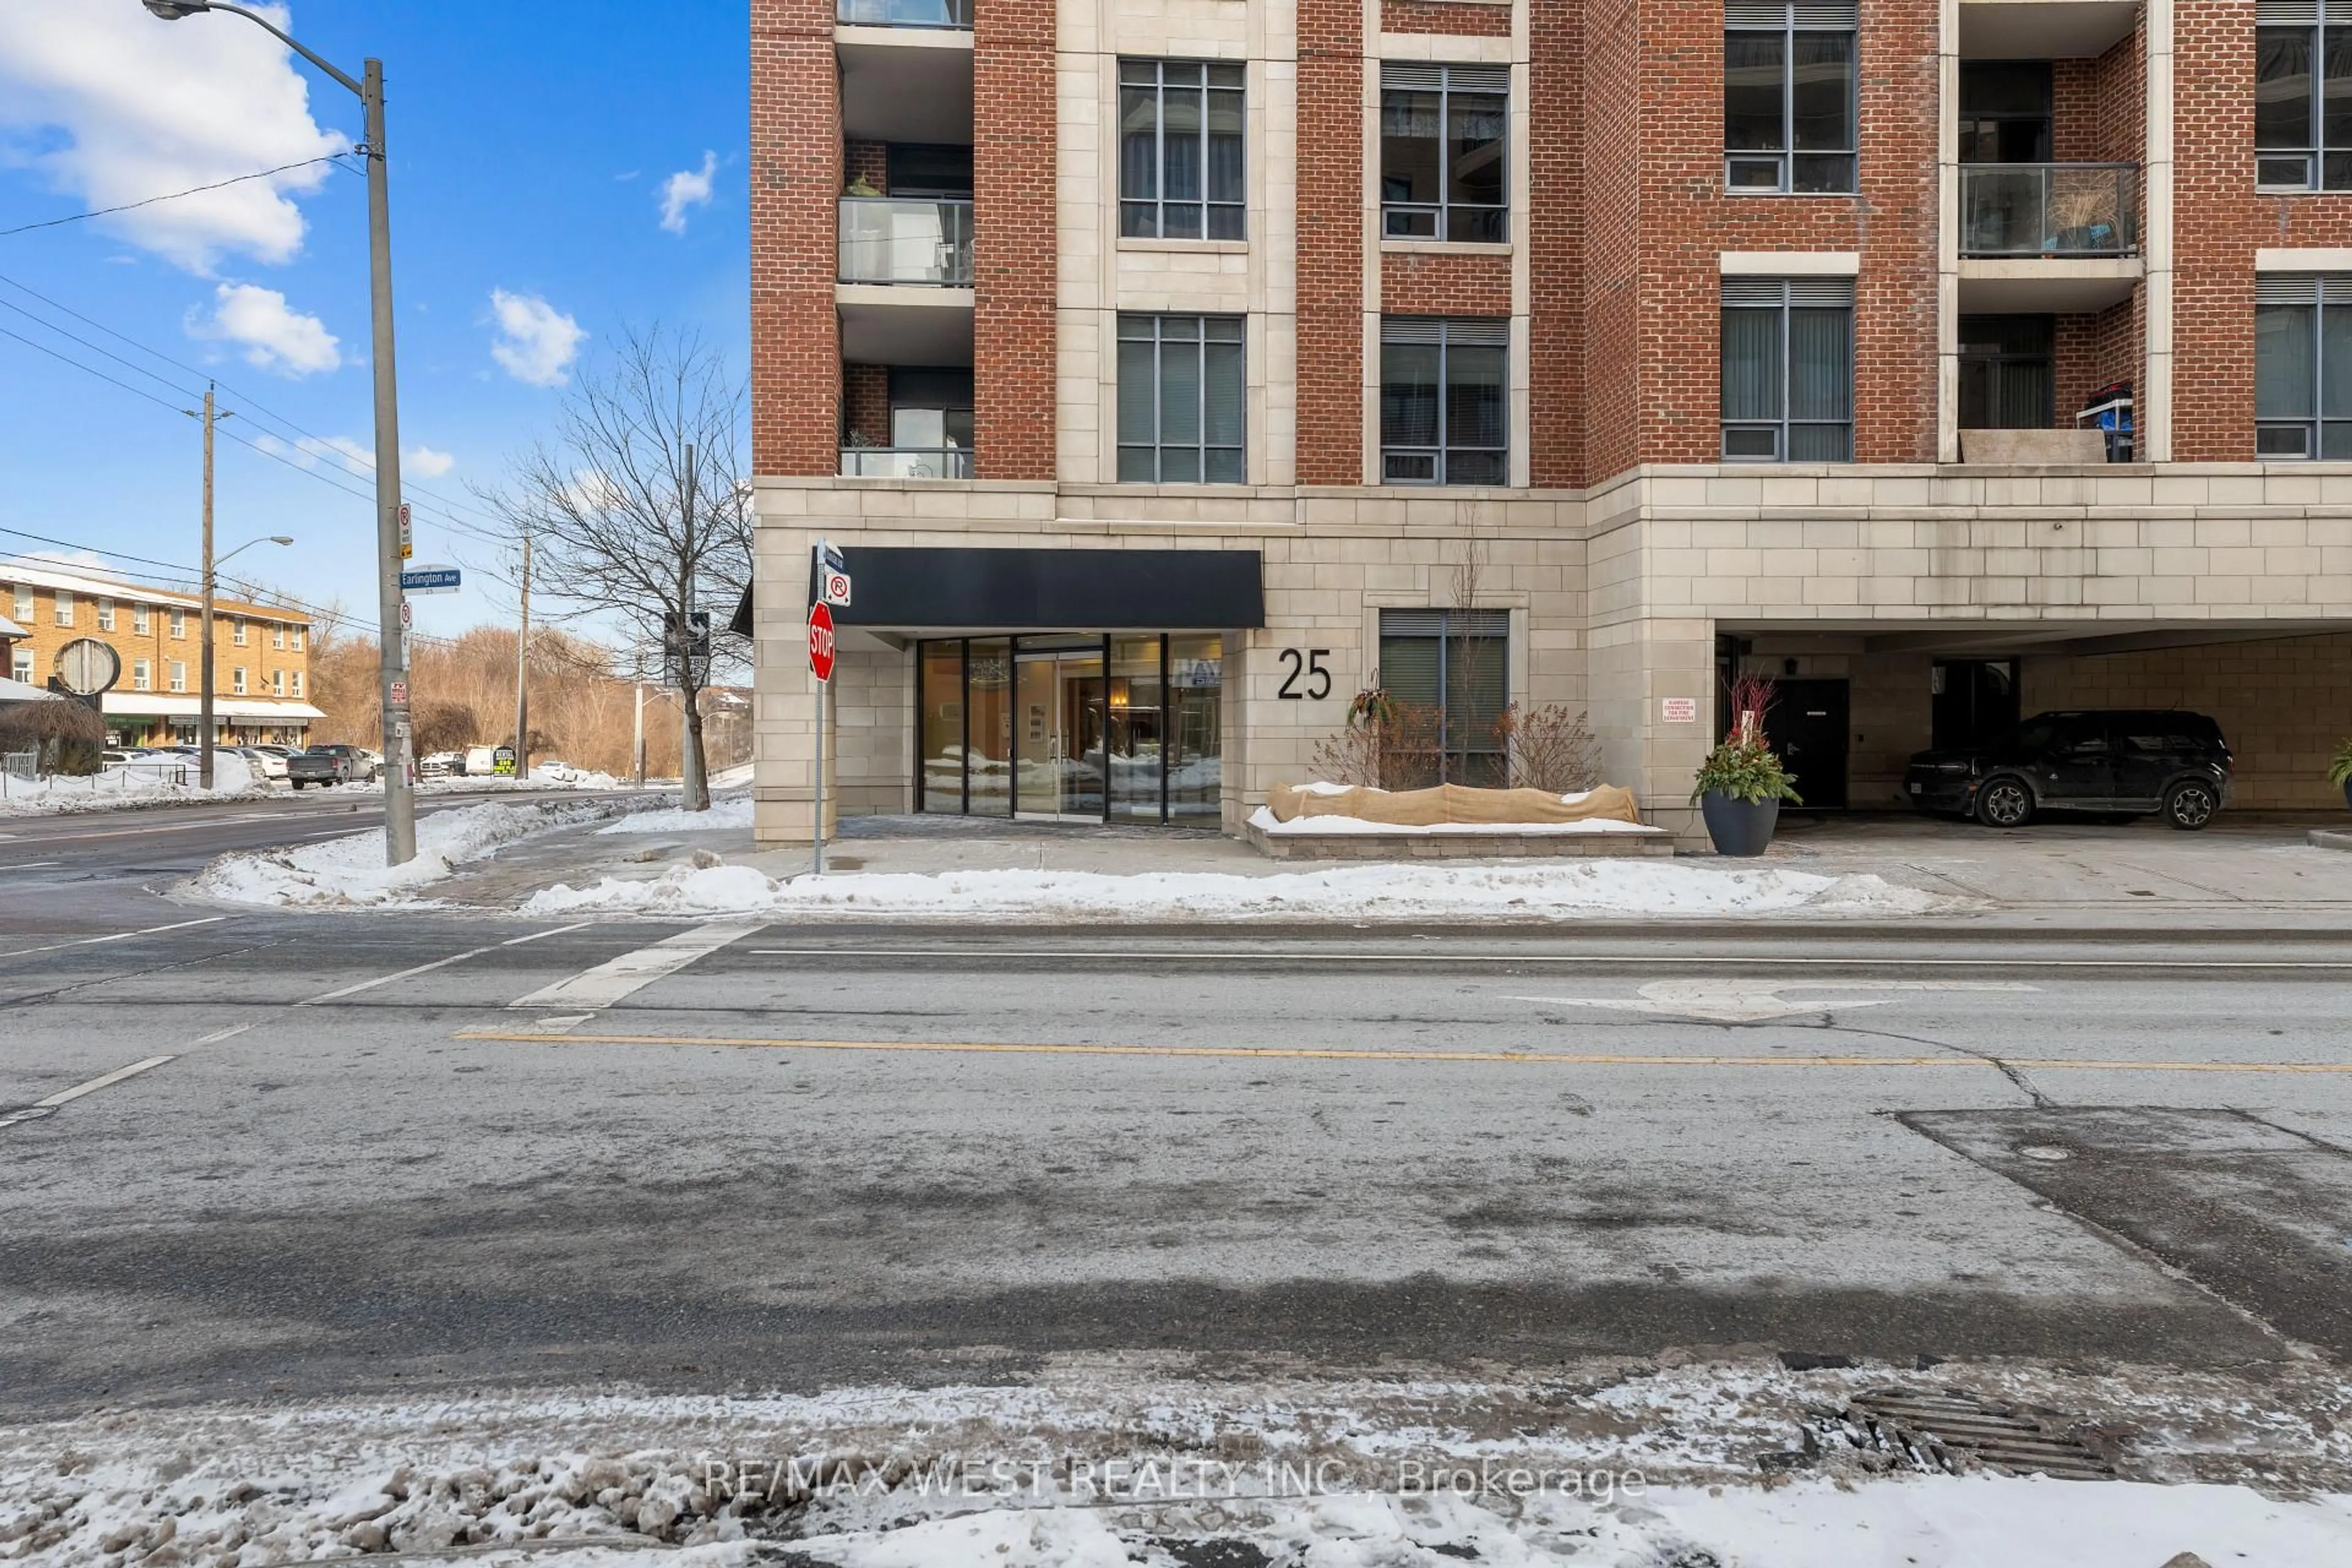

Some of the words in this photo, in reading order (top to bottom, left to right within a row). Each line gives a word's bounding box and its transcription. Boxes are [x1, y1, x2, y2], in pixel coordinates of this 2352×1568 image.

[402, 573, 442, 587] Earlington
[445, 573, 456, 582] Ave
[811, 624, 832, 658] STOP
[1278, 648, 1331, 700] 25
